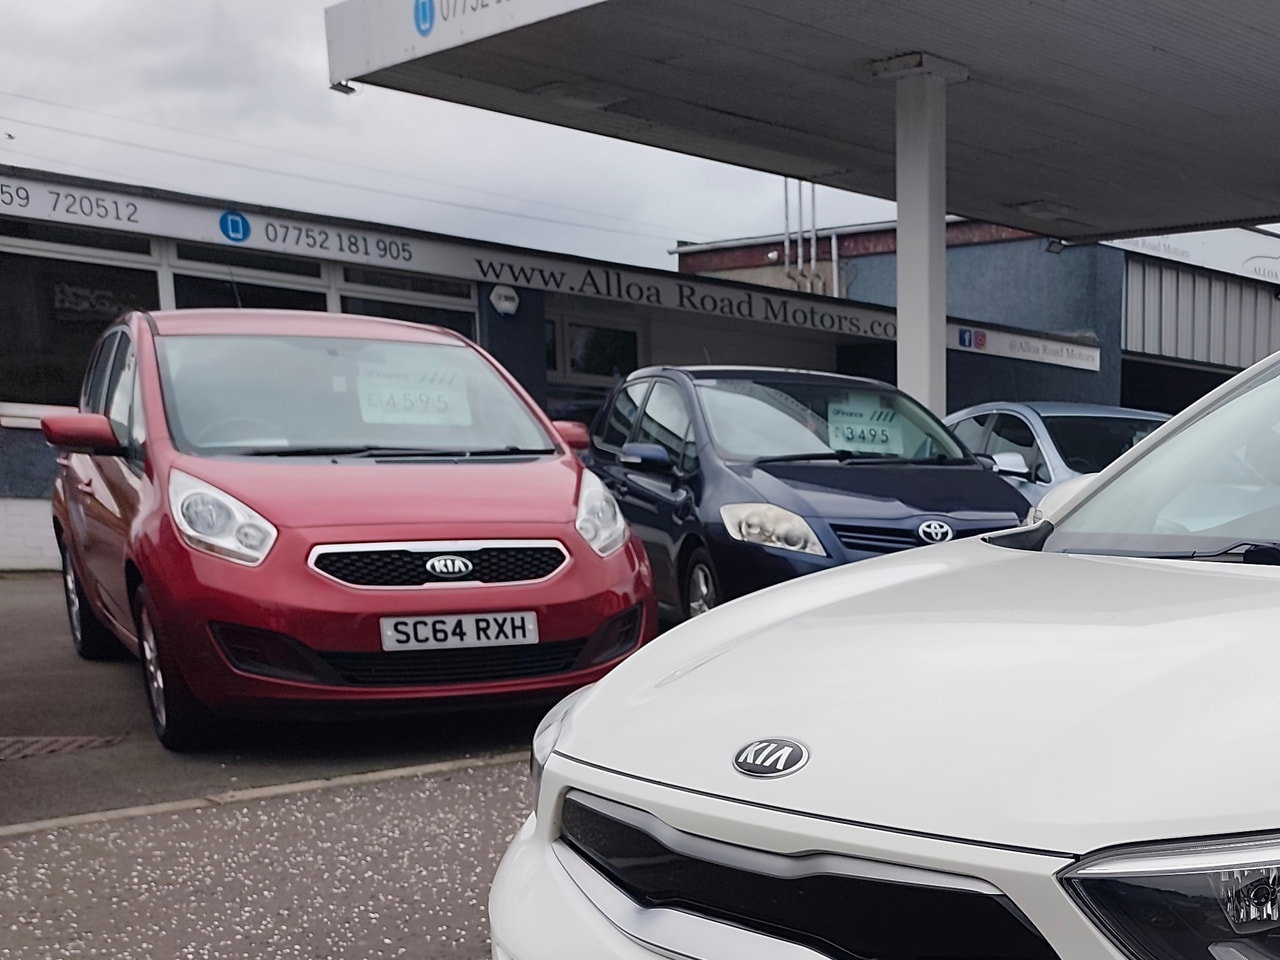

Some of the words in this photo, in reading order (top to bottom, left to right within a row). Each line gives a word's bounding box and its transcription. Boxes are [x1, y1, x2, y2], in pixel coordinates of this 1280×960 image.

[48, 191, 139, 223] 720512
[265, 223, 329, 250] 07752
[336, 233, 370, 256] 181
[376, 239, 412, 261] 905
[676, 282, 754, 318] Road
[433, 558, 467, 573] KIA
[393, 619, 467, 644] SC64
[474, 616, 527, 641] RXH
[738, 742, 793, 770] KIA
